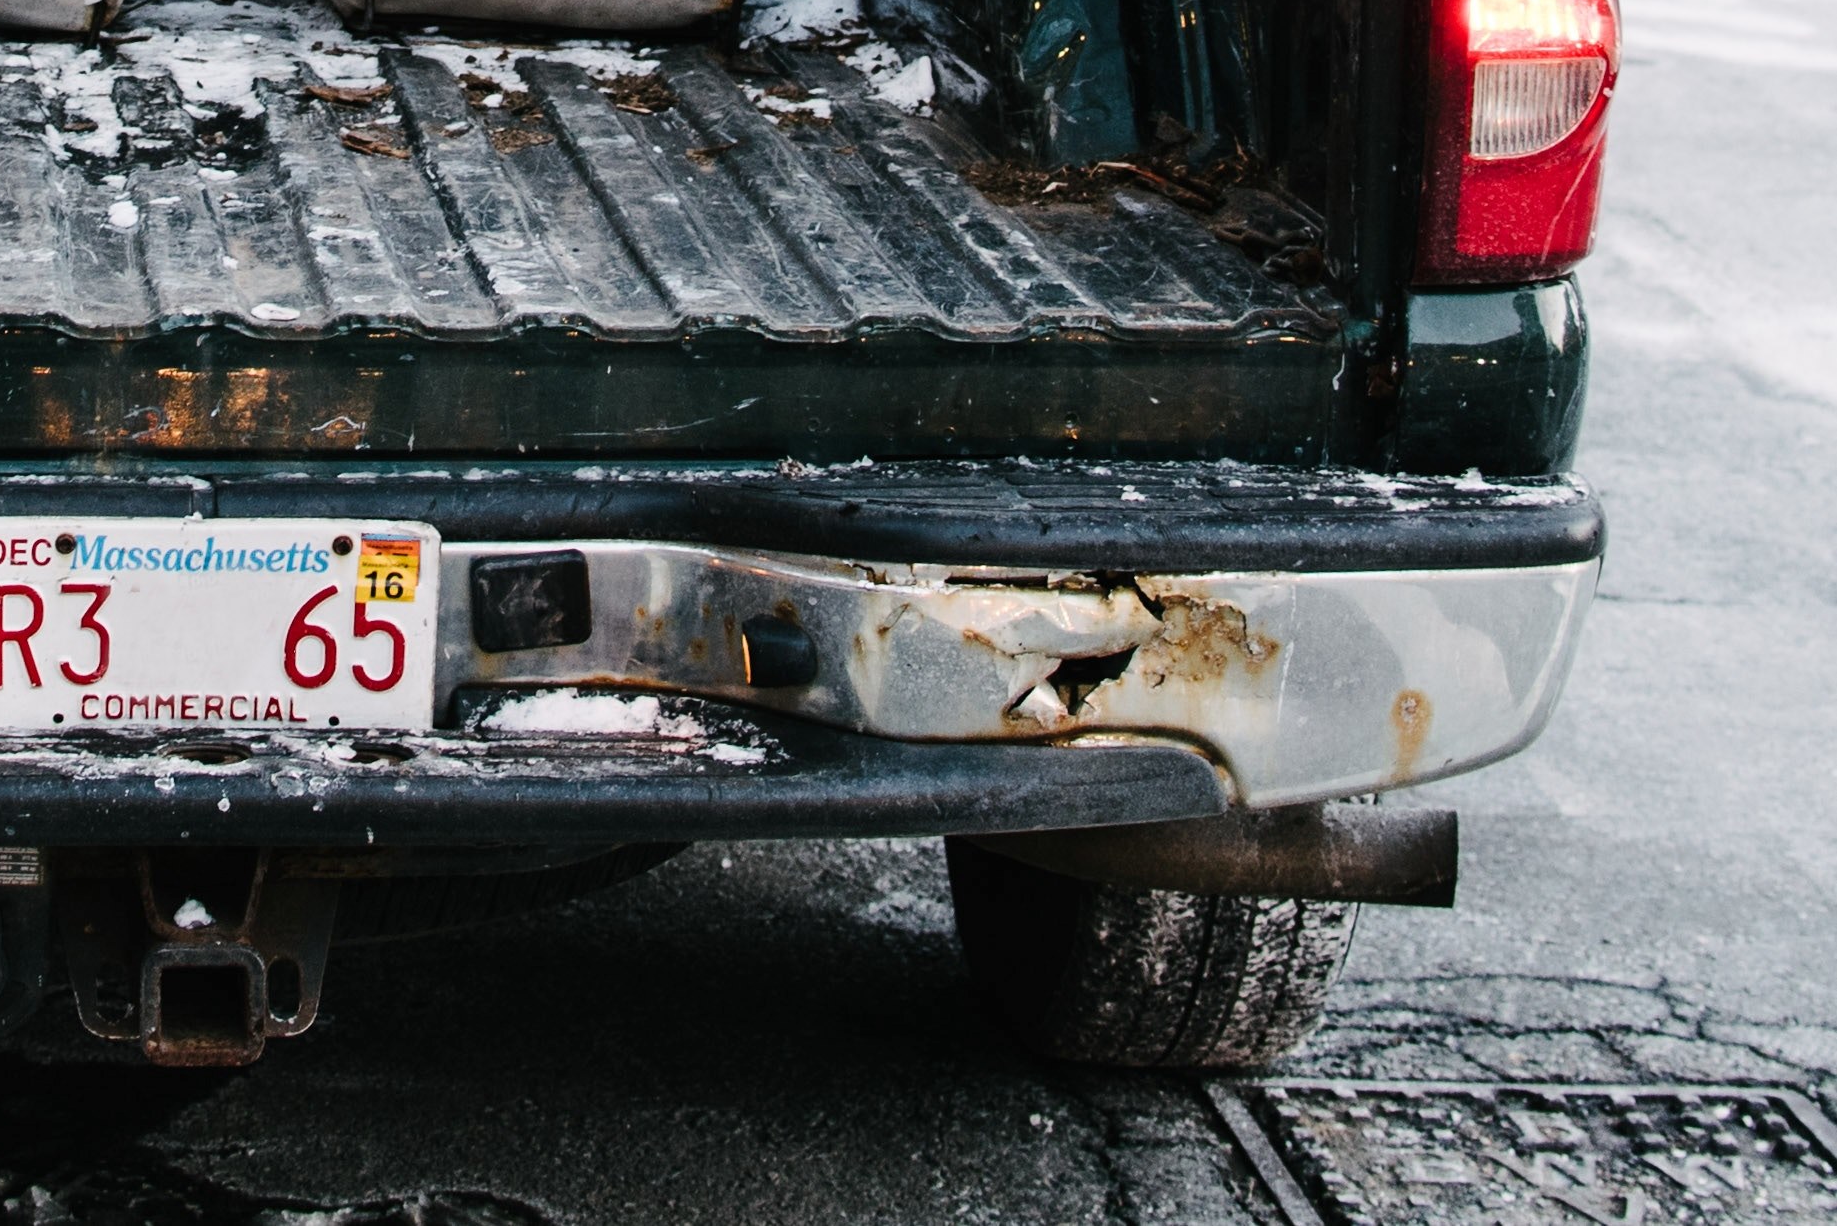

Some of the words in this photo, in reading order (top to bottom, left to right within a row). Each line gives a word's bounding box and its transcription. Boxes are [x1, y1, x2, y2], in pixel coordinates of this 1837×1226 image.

[69, 534, 330, 573] Massachusetts
[365, 571, 404, 599] 16
[80, 694, 308, 723] COMMERCIAL
